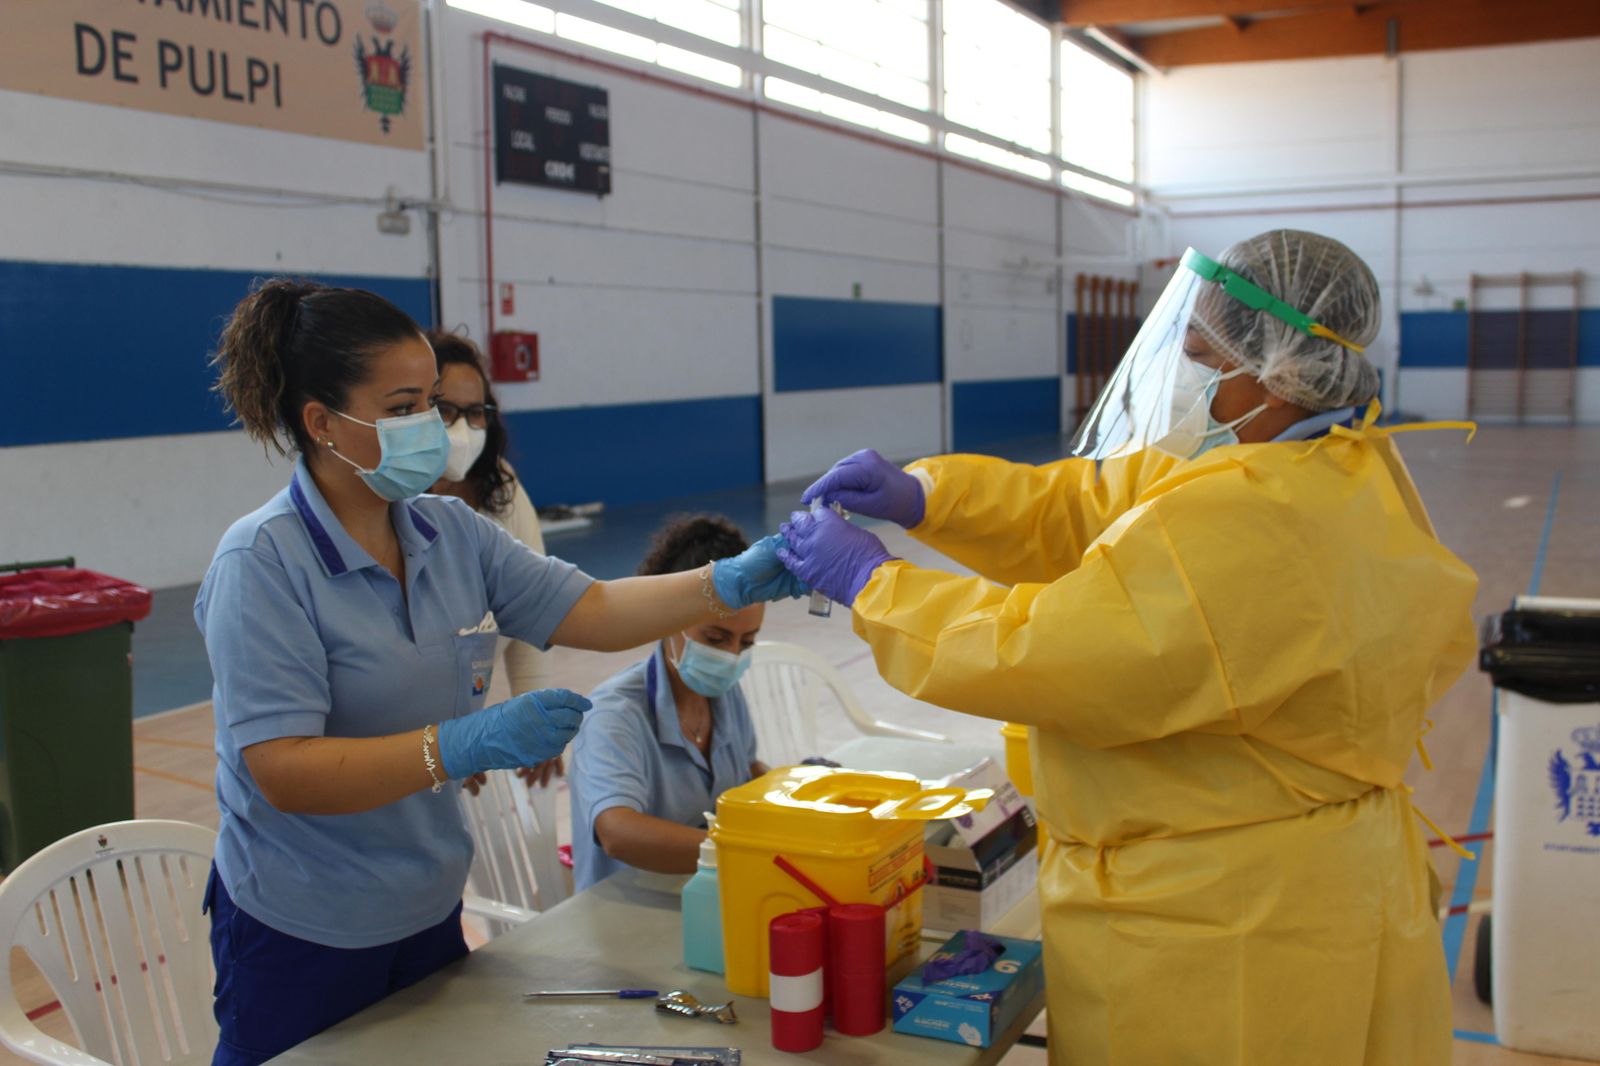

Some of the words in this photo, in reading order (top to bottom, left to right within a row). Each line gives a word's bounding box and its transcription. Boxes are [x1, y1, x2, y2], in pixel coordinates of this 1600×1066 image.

[138, 0, 341, 45] IENTO
[74, 22, 139, 84] DE
[157, 39, 283, 108] PULPI
